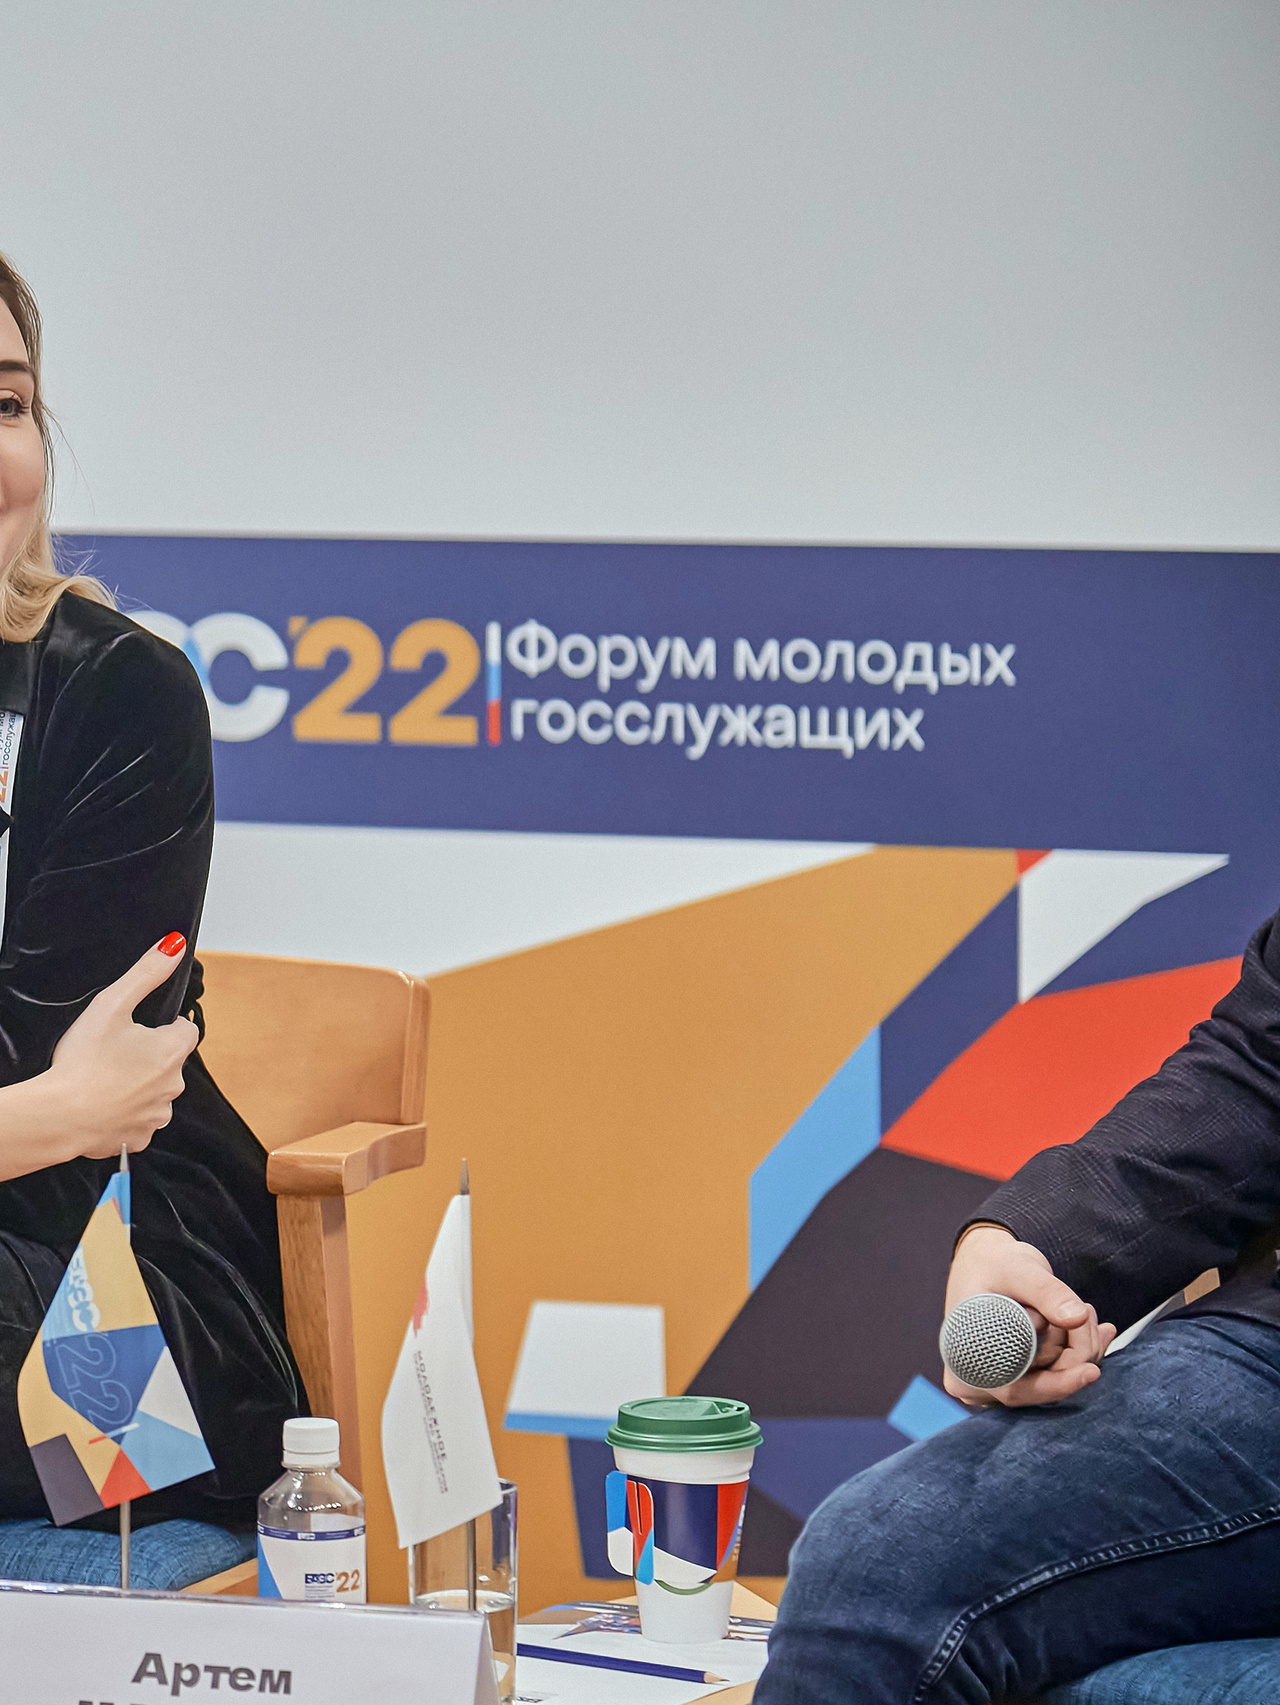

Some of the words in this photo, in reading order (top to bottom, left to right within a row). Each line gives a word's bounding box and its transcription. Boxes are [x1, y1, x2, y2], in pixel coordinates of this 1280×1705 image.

[505, 618, 717, 694] Форум
[732, 636, 1017, 696] молодых
[509, 697, 926, 761] госслужащих
[131, 1652, 293, 1697] Артем
